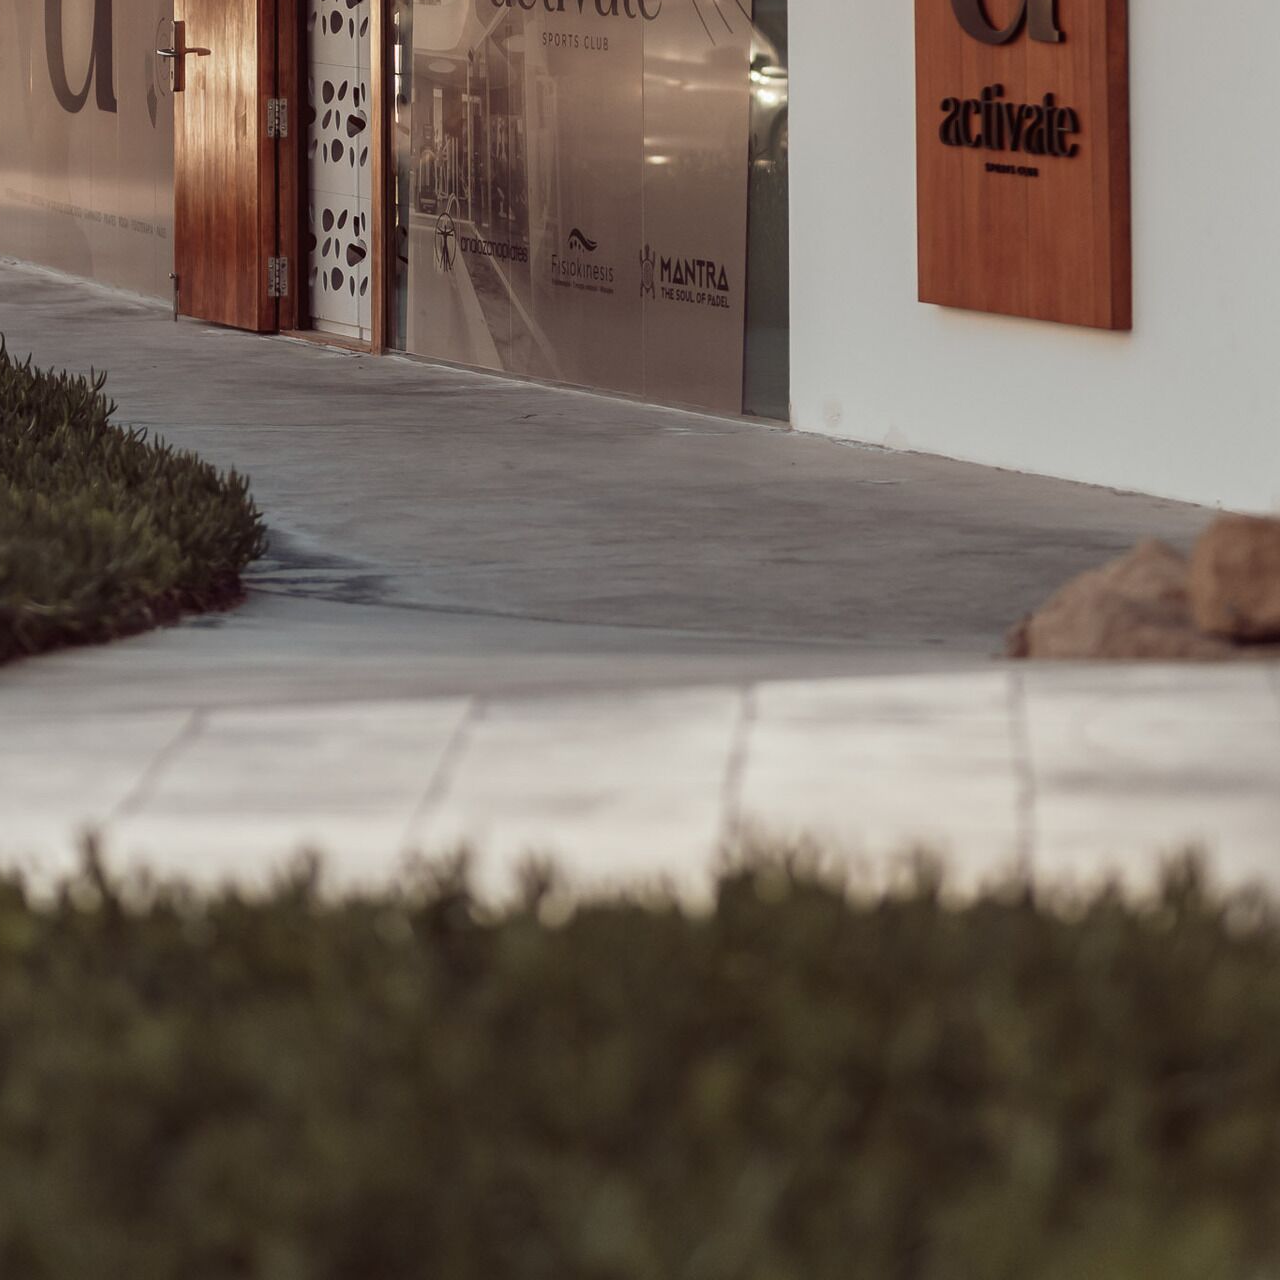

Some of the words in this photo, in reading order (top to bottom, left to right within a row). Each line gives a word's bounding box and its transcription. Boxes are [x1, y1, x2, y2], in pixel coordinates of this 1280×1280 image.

[542, 31, 579, 49] SPORTS
[584, 34, 609, 51] CLUB
[939, 83, 1081, 158] activate
[551, 254, 614, 282] Fisiokinesis
[660, 255, 730, 292] MANTRA
[661, 287, 674, 300] THE
[675, 289, 694, 303] SOUL
[696, 293, 706, 304] OF
[707, 294, 730, 308] PADEL
